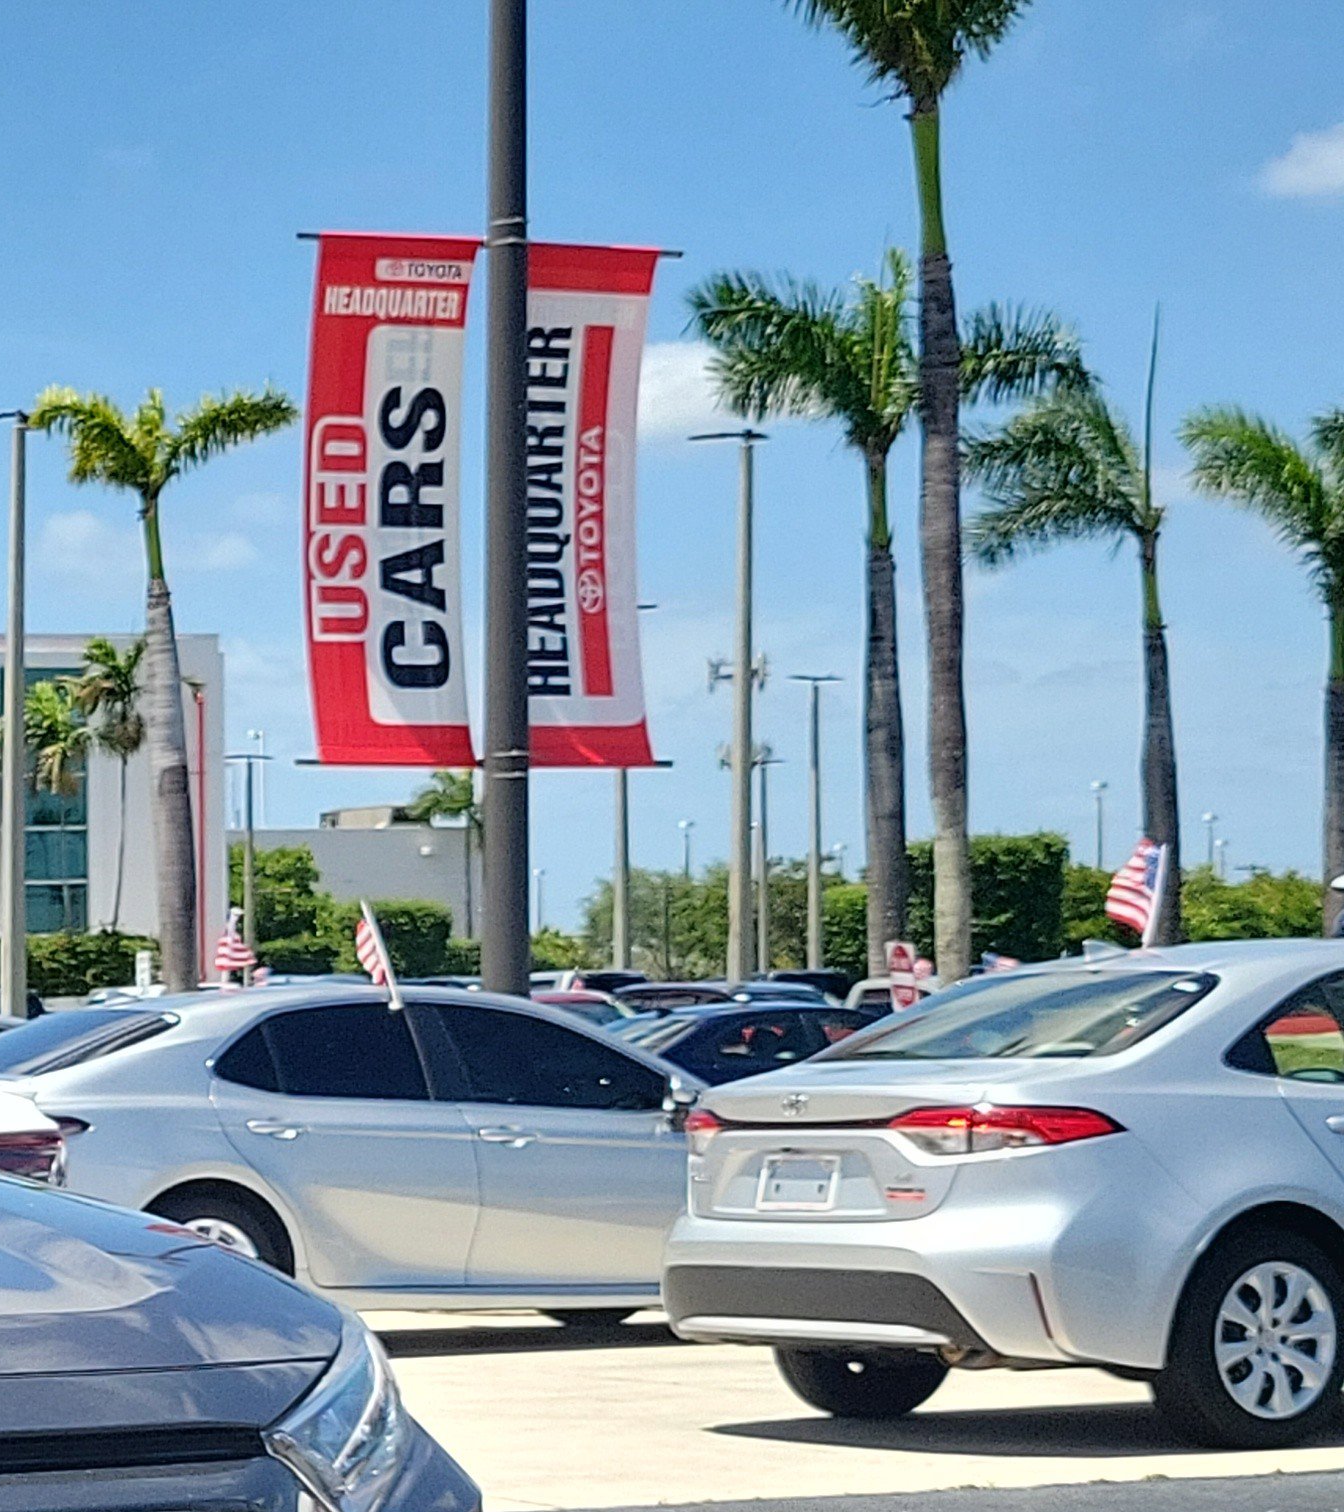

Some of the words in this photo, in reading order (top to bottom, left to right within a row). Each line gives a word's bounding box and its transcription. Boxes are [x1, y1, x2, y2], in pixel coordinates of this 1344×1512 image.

[325, 286, 459, 319] HEADQUARTER
[408, 263, 462, 279] TOYOTA
[315, 422, 368, 639] USED
[380, 386, 450, 689] CARS
[527, 325, 572, 697] HEADQUARTER
[579, 425, 602, 561] TOYOTA
